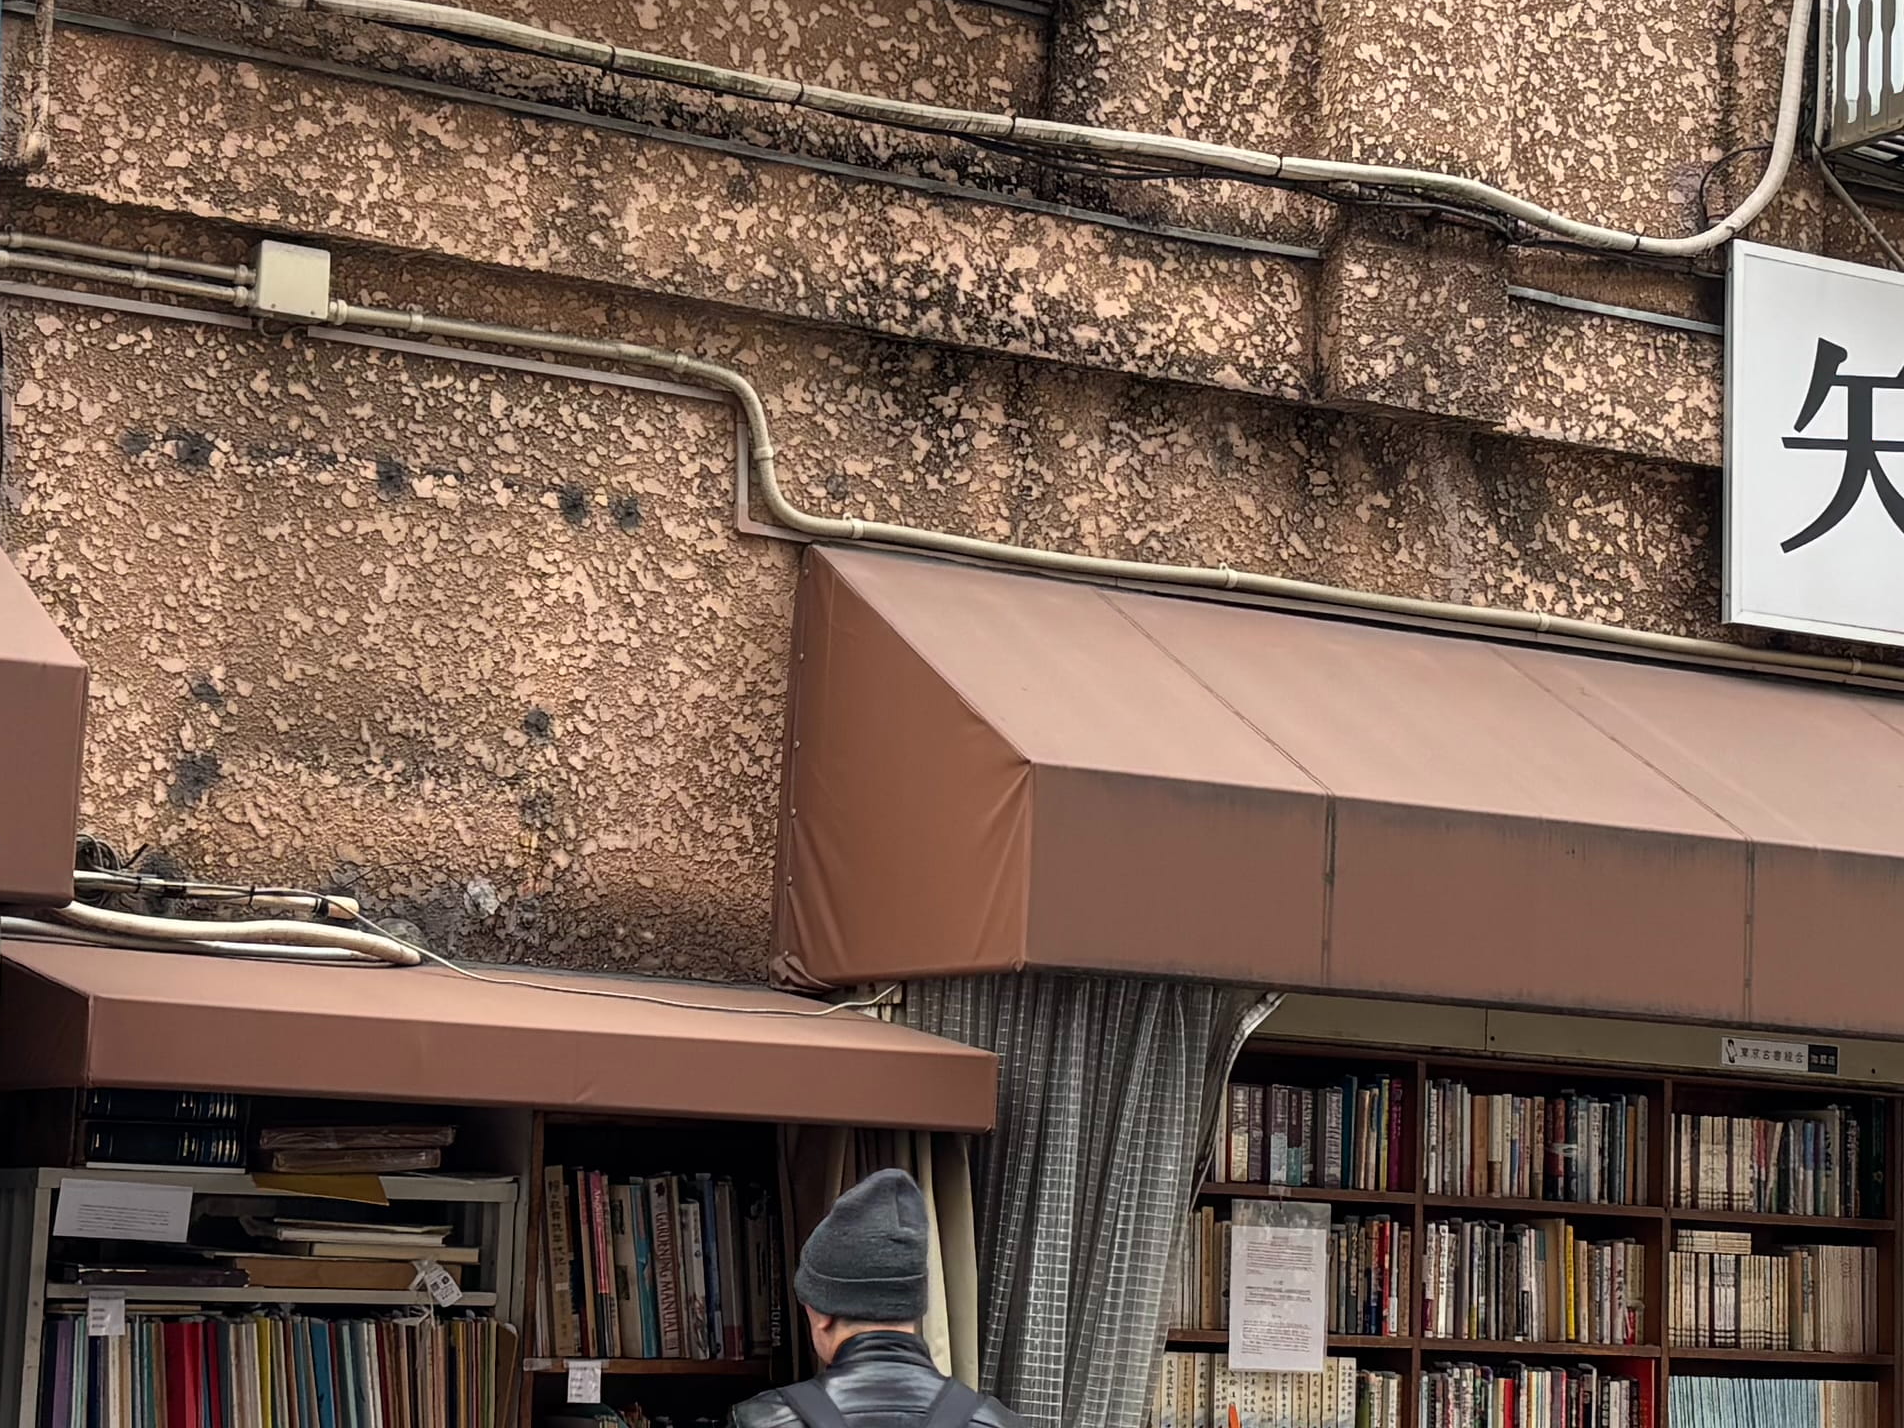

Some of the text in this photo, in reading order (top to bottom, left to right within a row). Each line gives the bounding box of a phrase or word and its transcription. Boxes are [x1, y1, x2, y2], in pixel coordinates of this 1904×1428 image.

[1740, 1047, 1804, 1064] 東京古書組合
